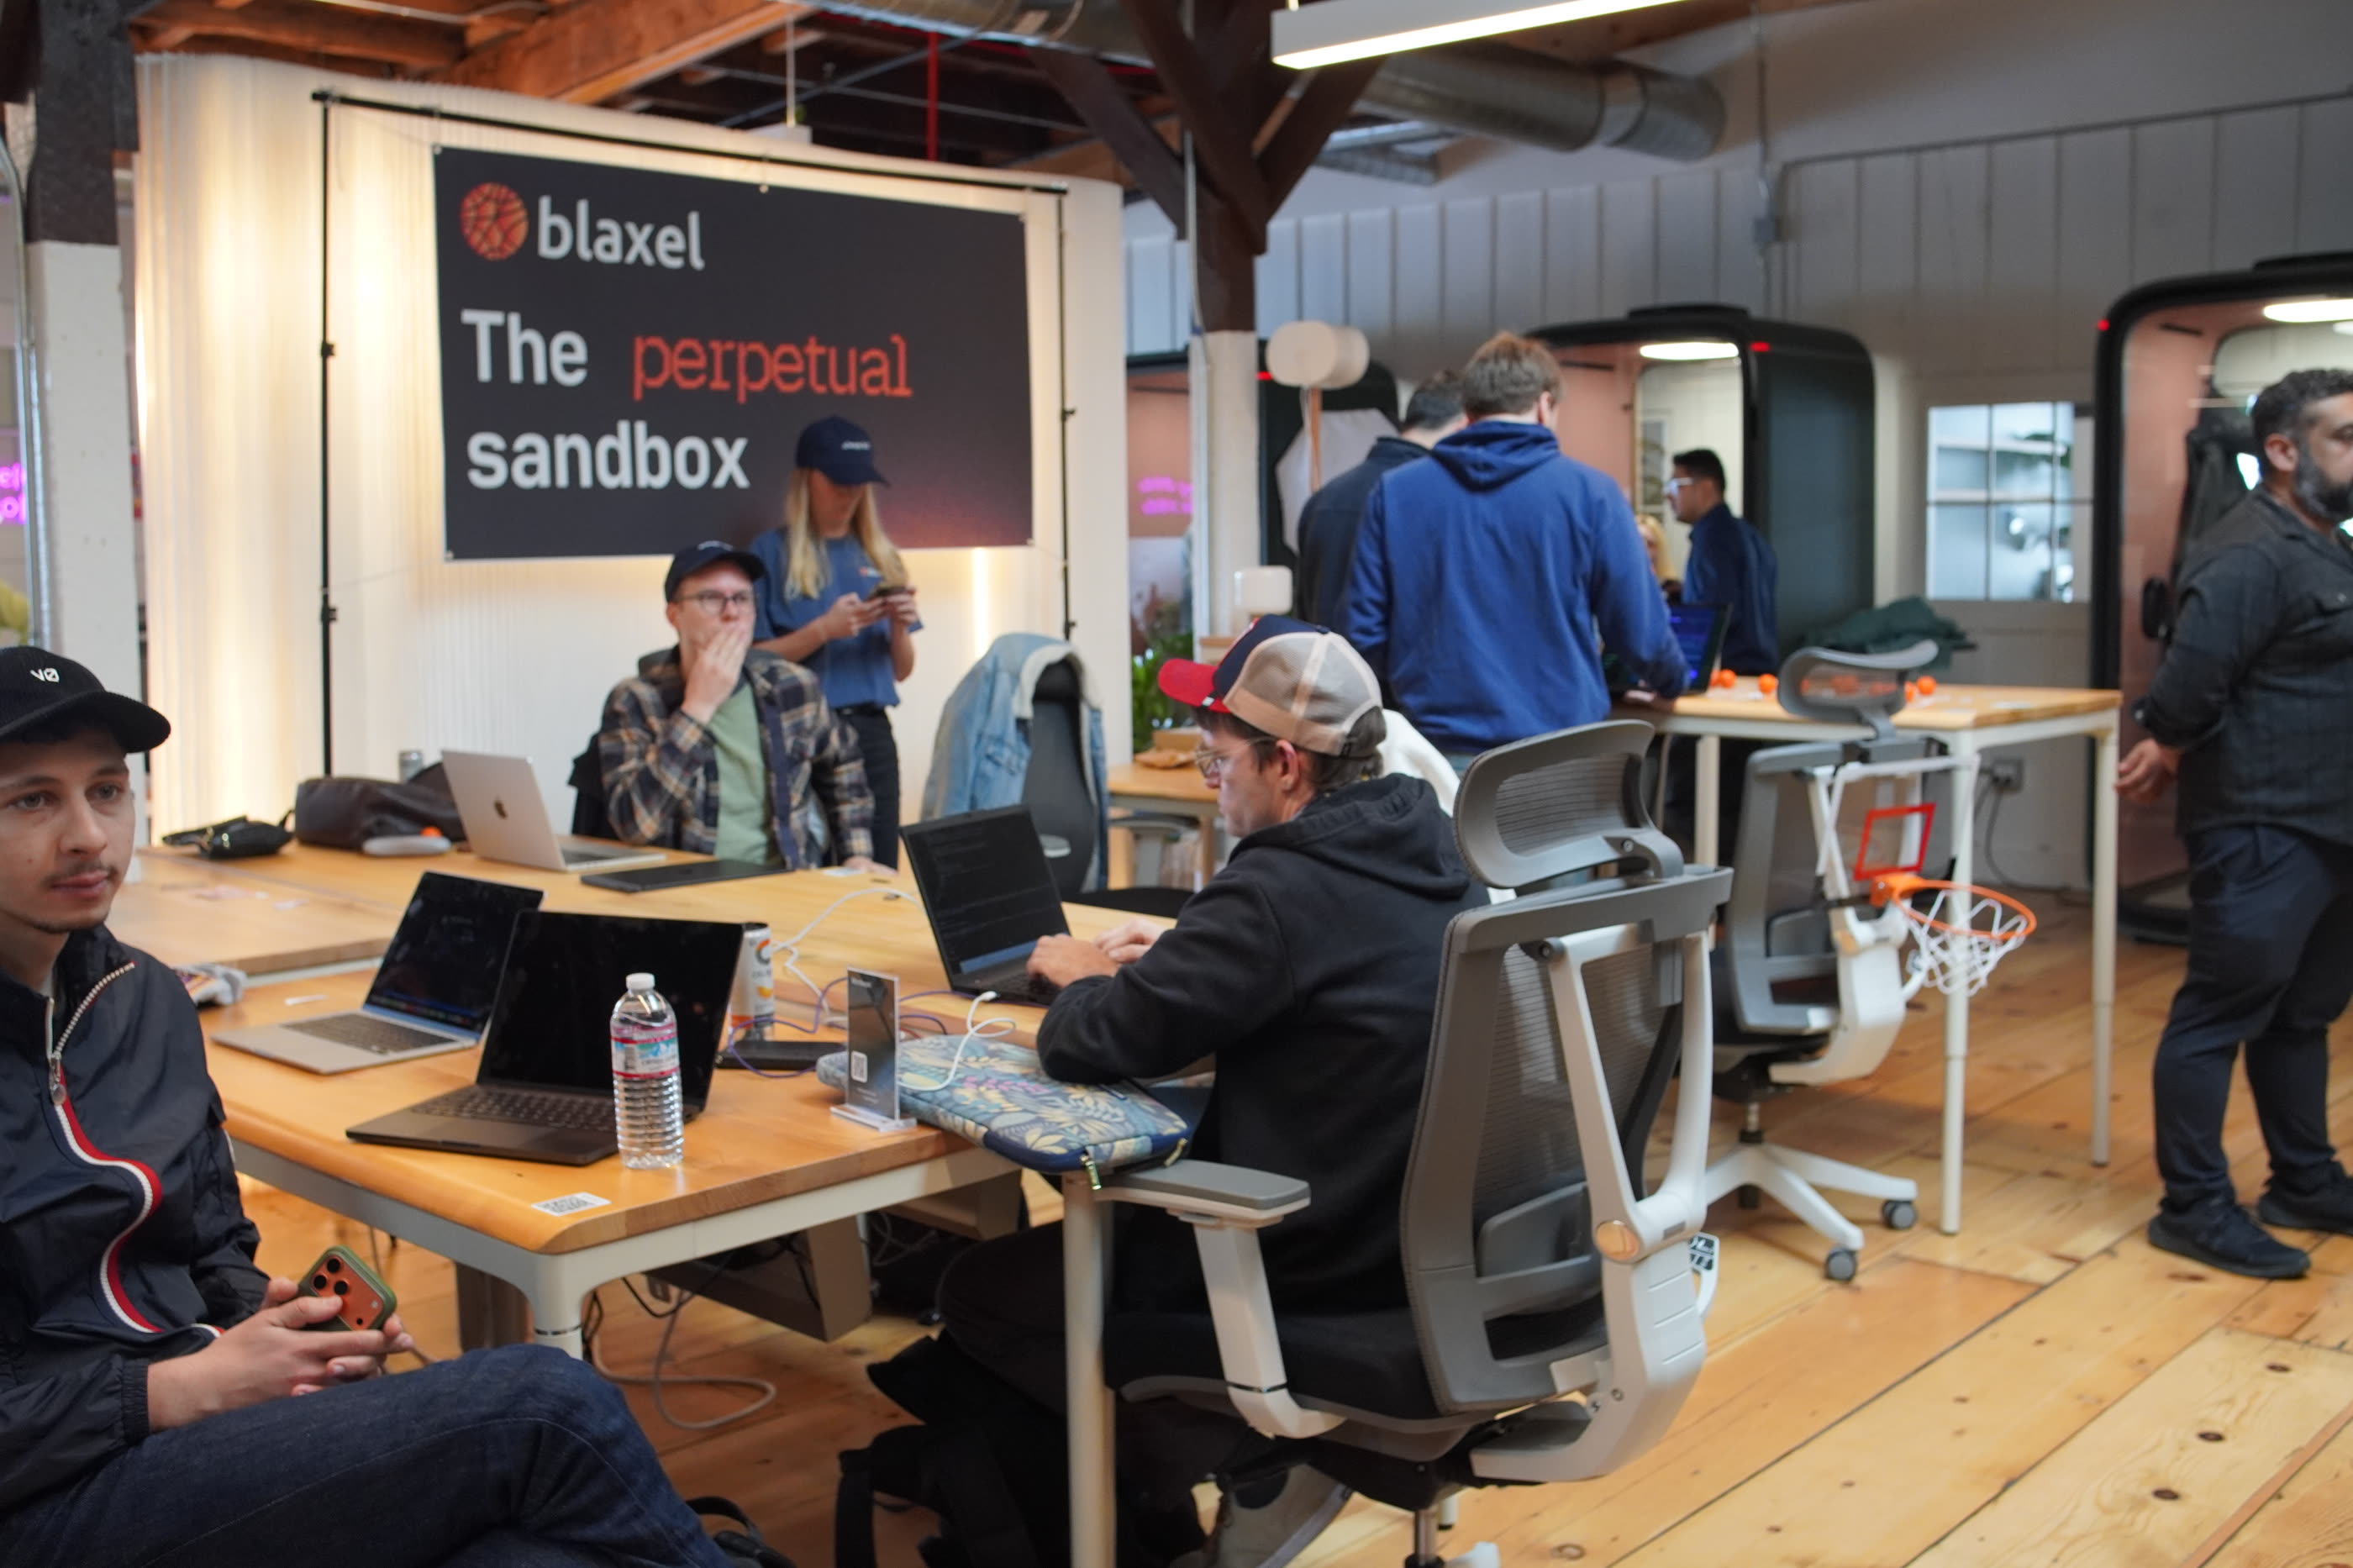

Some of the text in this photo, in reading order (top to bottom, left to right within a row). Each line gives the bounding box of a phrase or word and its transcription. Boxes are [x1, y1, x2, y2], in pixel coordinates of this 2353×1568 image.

[537, 195, 705, 271] blaxel
[461, 308, 913, 404] The perpetual
[466, 419, 750, 490] sandbox
